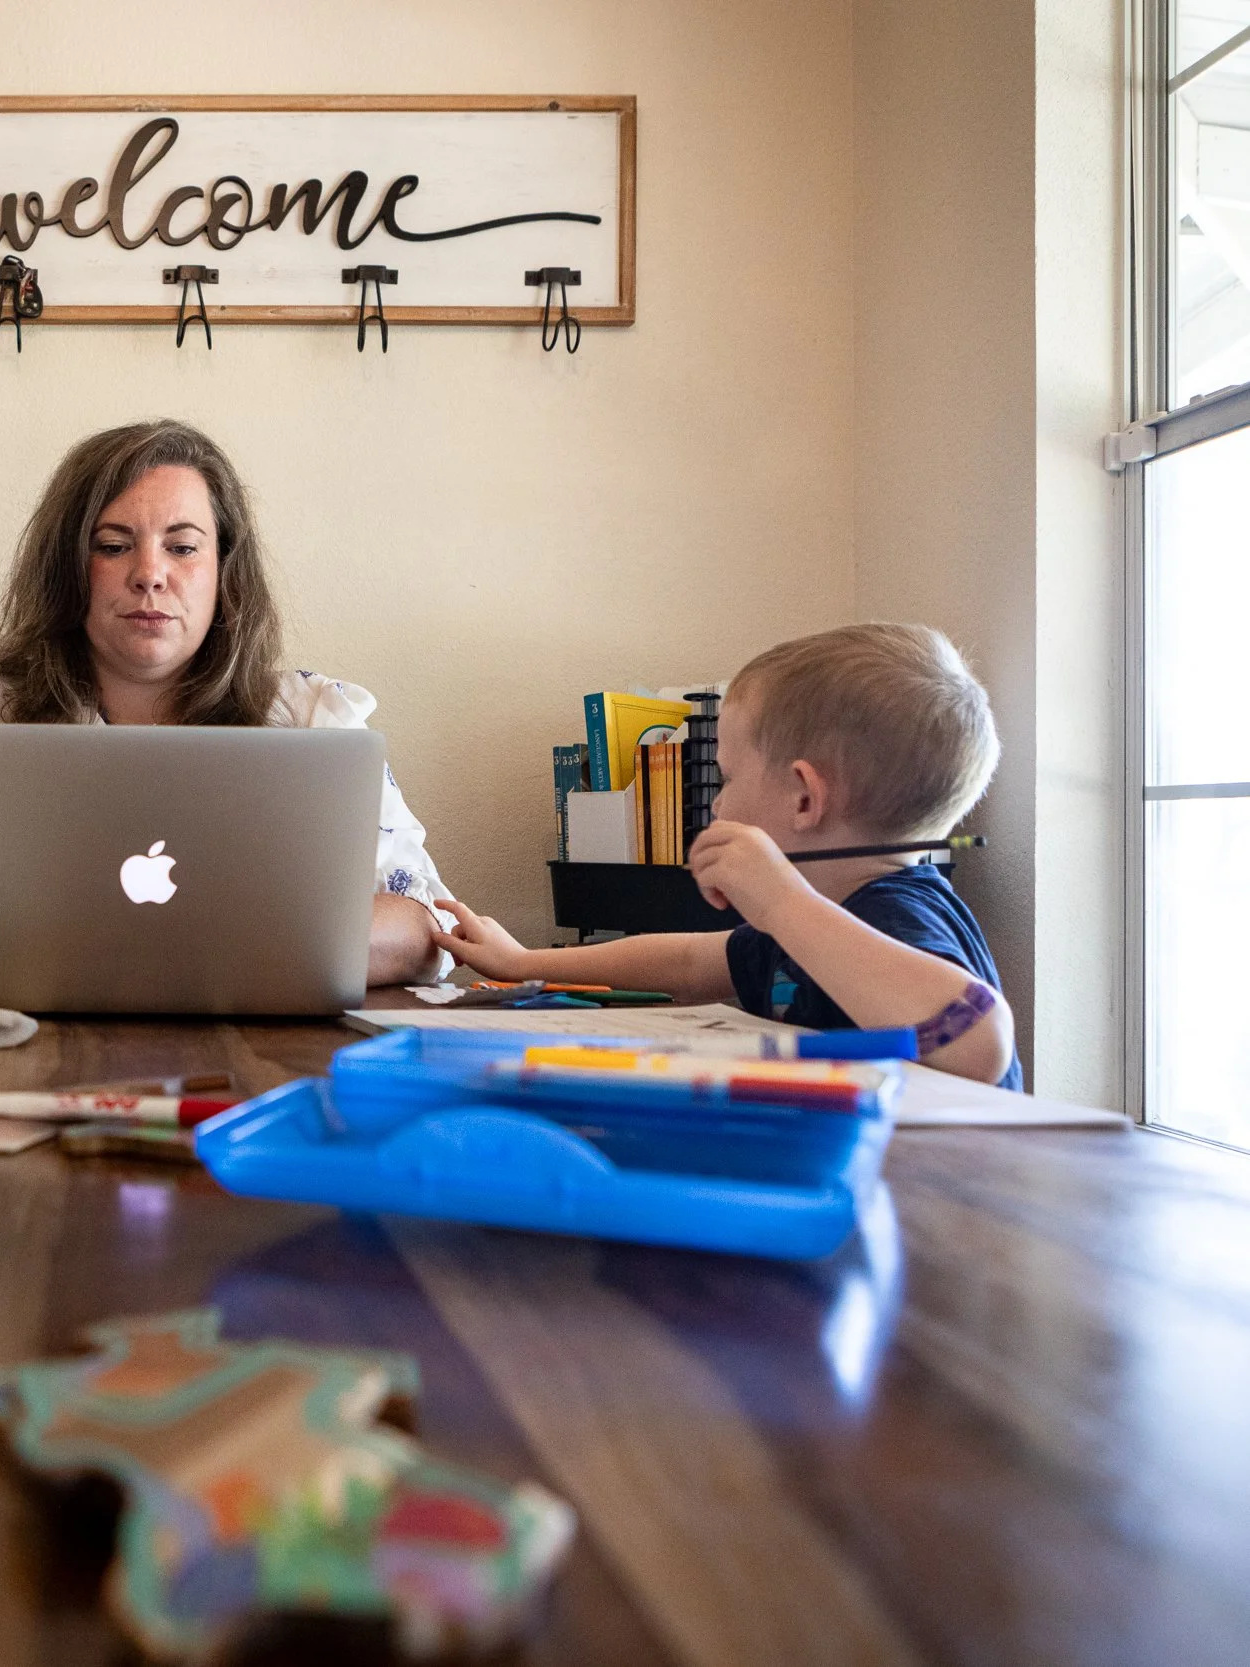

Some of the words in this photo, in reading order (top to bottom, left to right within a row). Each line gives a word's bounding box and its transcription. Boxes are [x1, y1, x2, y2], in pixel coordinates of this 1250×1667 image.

[591, 703, 599, 714] 3
[594, 729, 602, 765] LANGUAGE
[573, 753, 580, 764] 3
